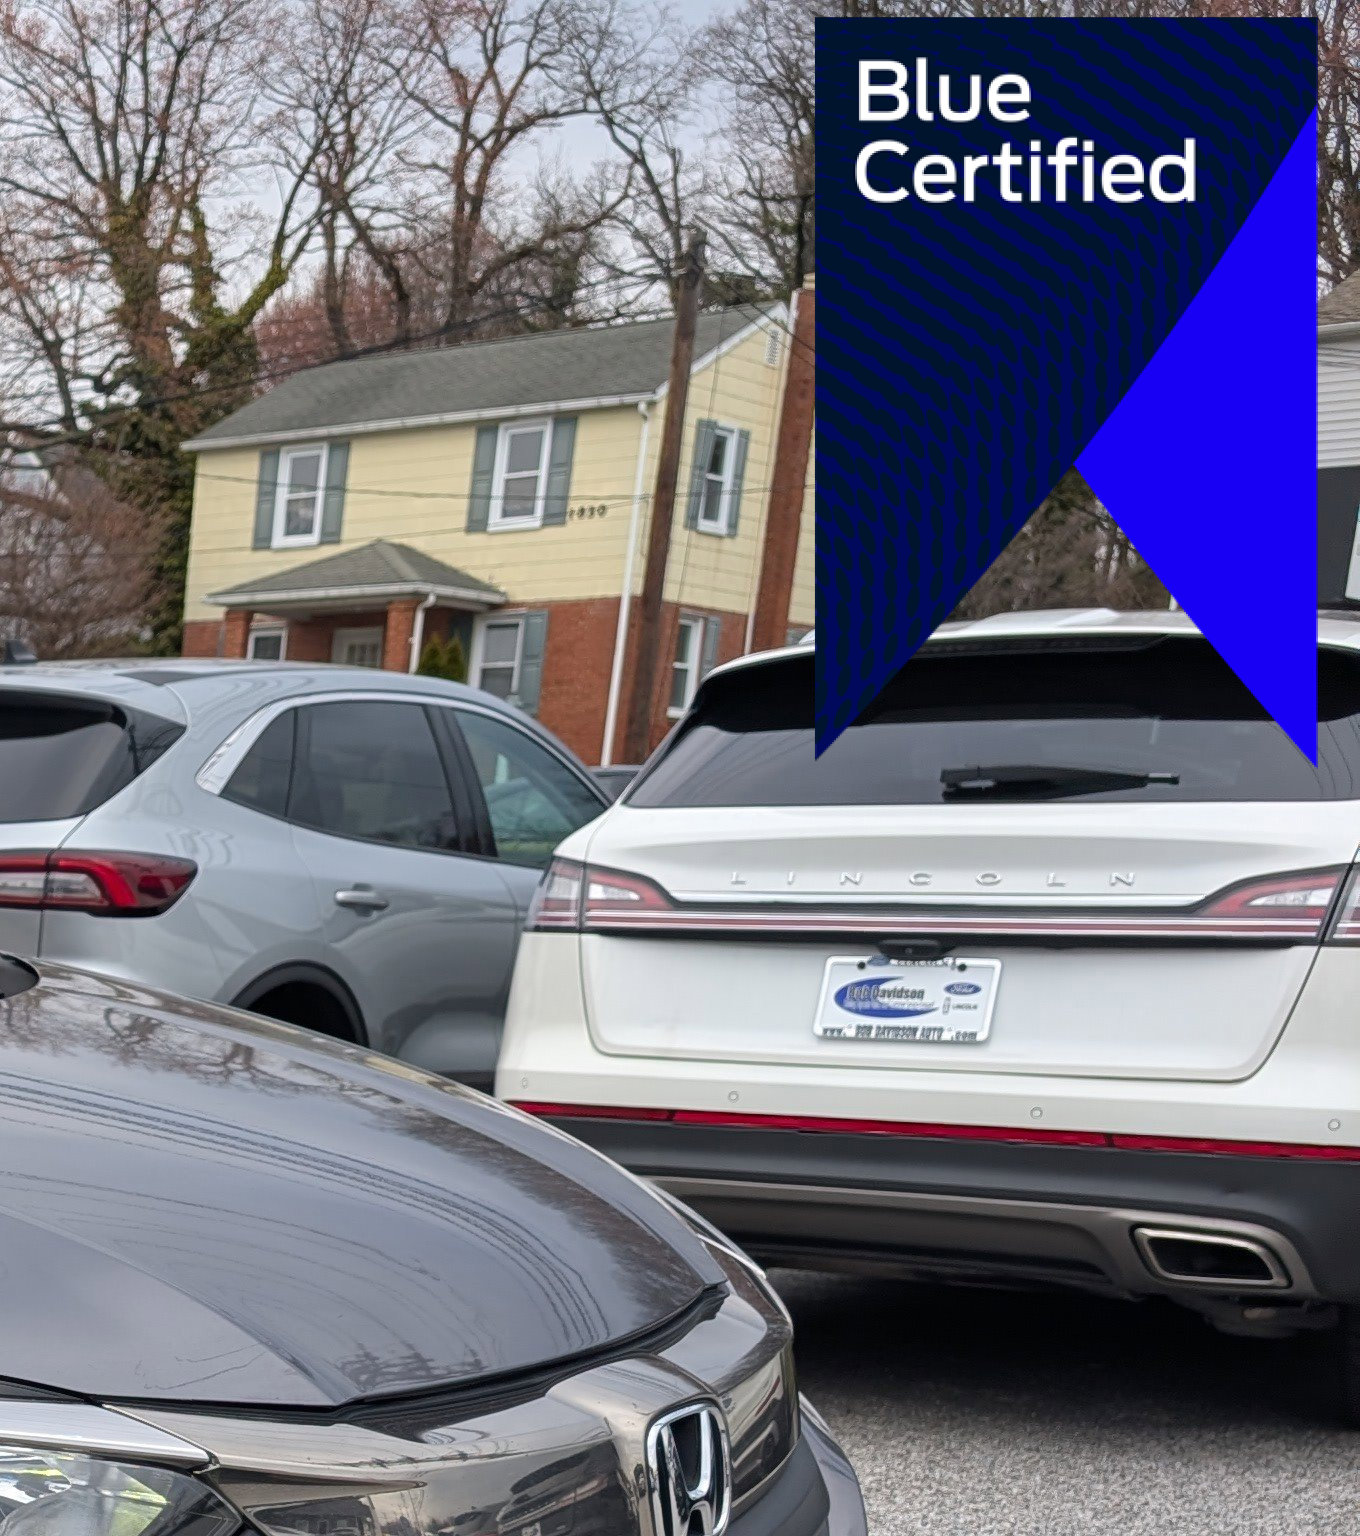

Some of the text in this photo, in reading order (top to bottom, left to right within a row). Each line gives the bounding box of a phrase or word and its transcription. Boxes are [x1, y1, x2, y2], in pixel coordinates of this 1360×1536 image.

[730, 870, 1137, 888] LINCOLN
[847, 984, 925, 1001] Bob Davidson
